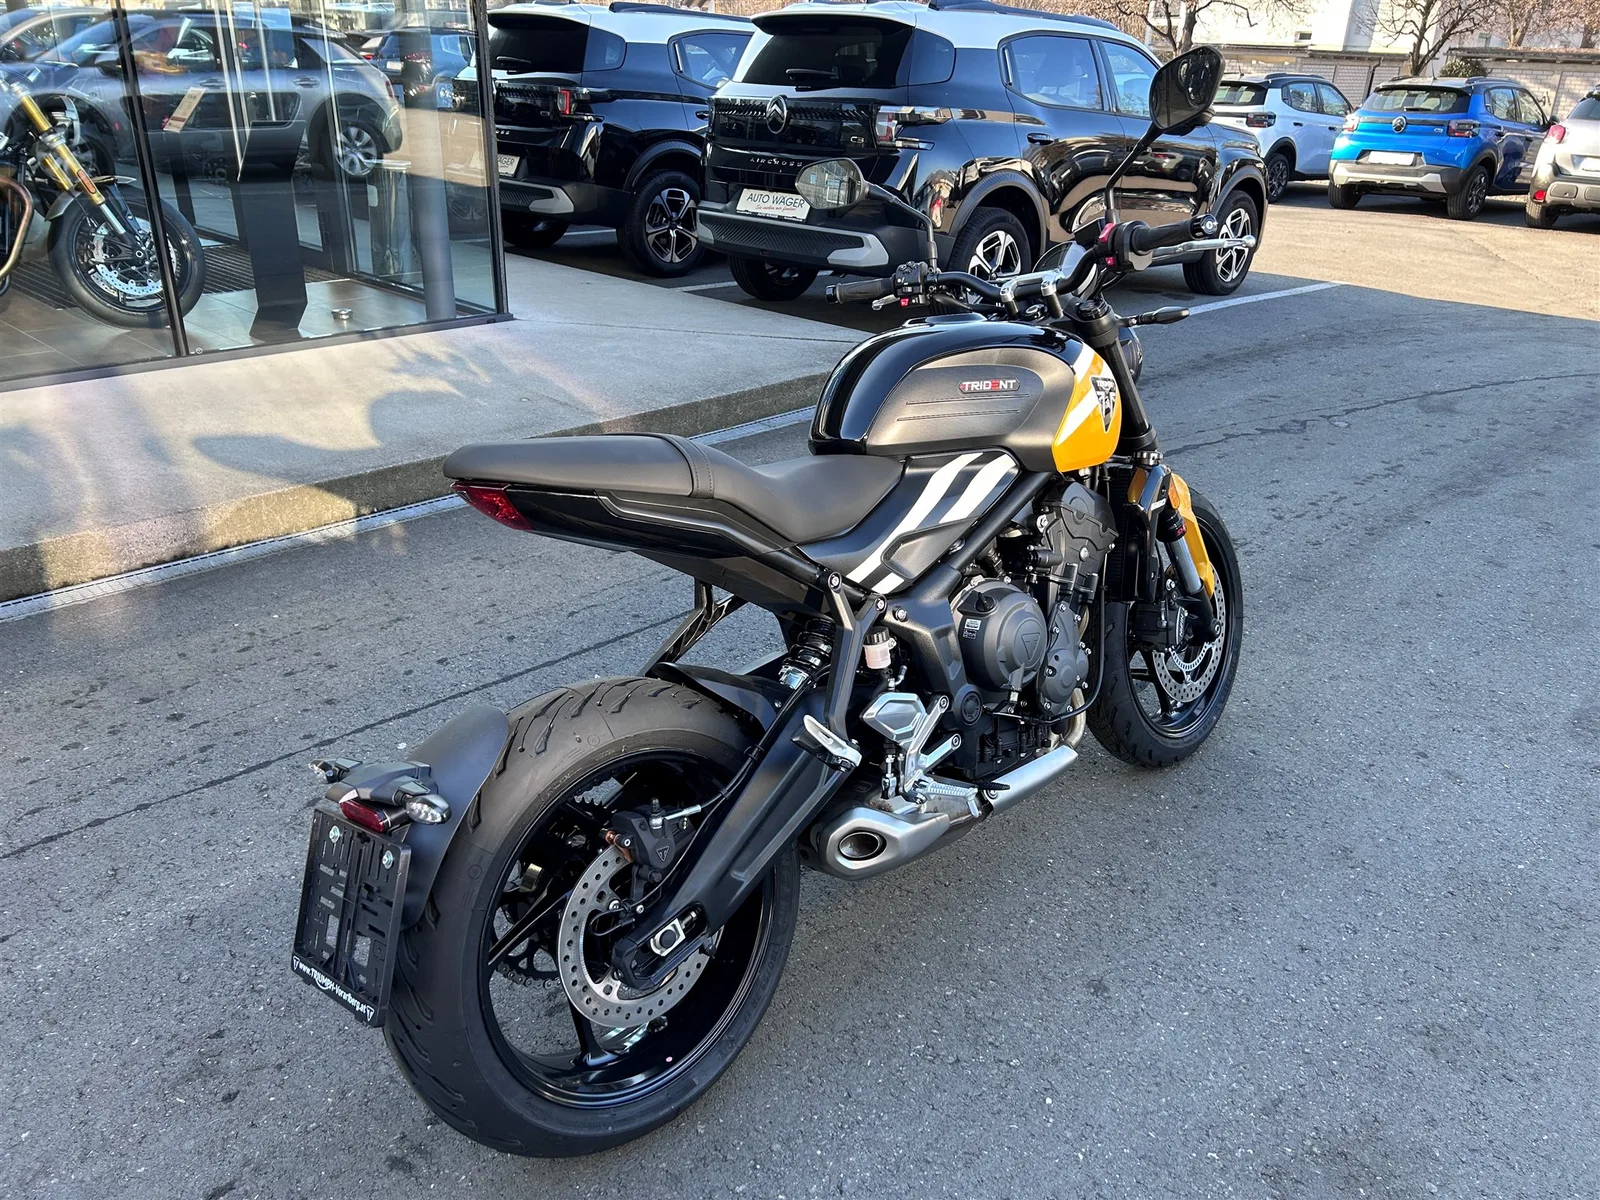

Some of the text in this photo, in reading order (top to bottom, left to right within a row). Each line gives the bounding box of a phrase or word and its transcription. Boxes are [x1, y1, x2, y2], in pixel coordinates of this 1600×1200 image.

[746, 193, 805, 208] AUTO WÄGER
[960, 379, 1017, 391] TRIDENT
